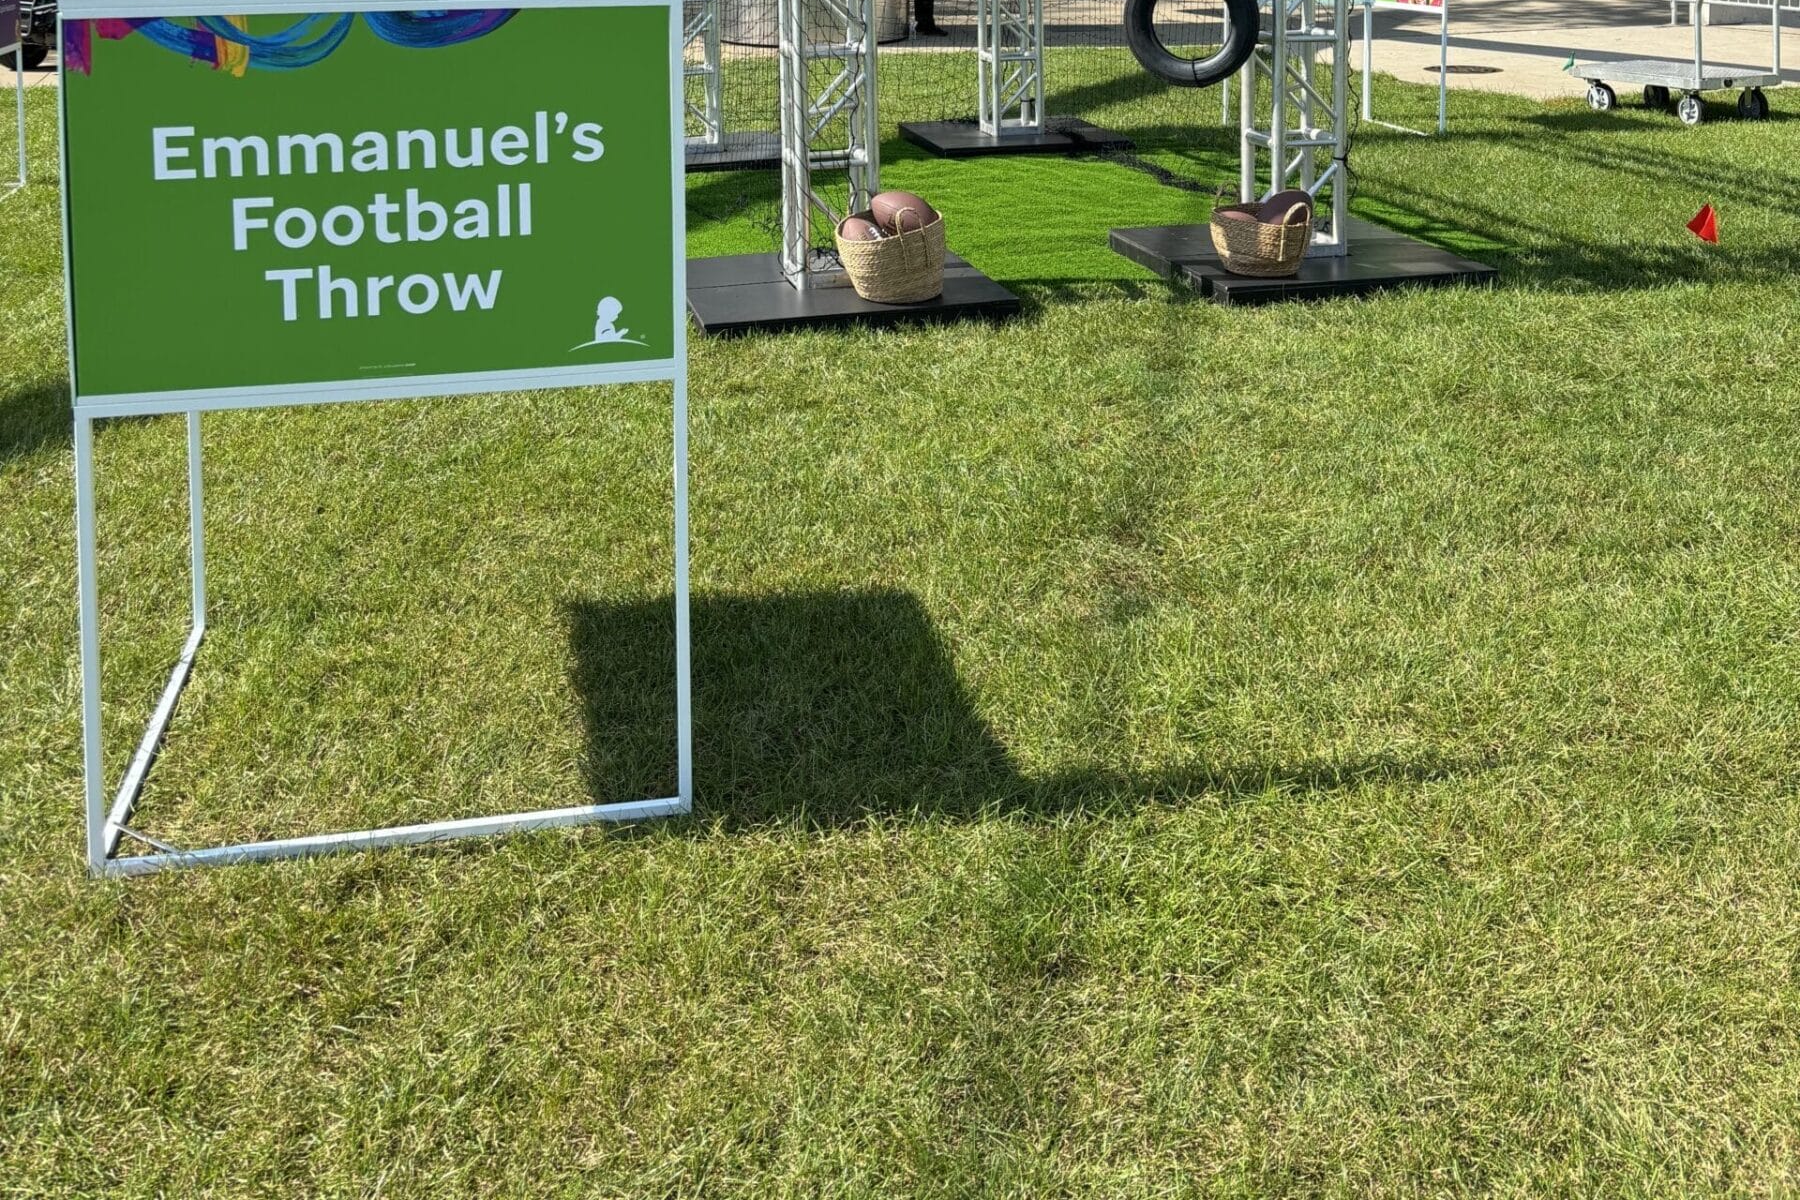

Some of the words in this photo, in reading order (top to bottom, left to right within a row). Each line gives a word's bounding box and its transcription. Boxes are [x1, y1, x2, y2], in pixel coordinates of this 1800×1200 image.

[152, 111, 605, 180] Emmanuel’s
[232, 183, 532, 251] Football
[265, 265, 502, 321] Throw
